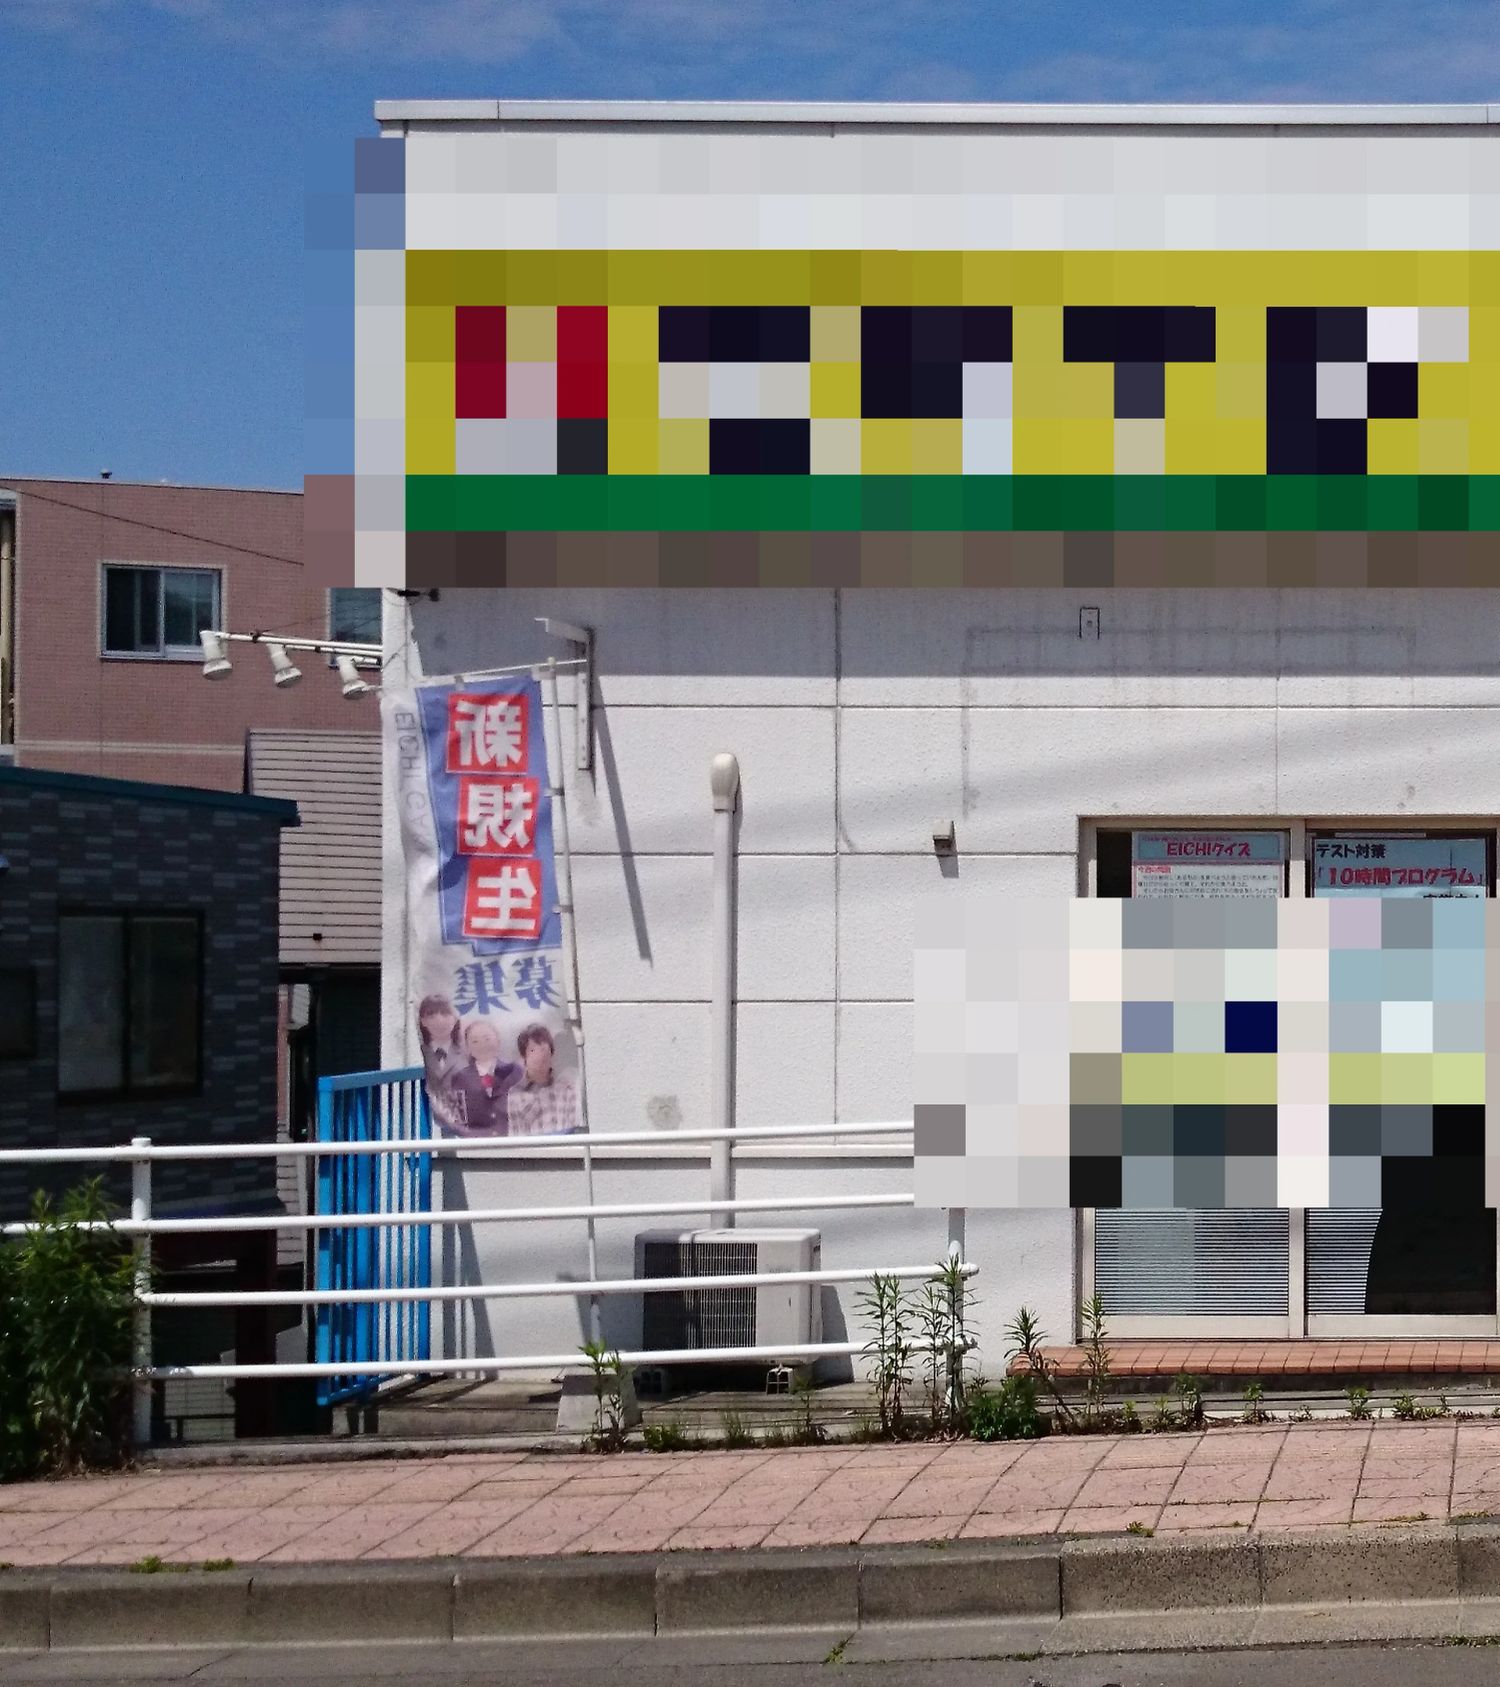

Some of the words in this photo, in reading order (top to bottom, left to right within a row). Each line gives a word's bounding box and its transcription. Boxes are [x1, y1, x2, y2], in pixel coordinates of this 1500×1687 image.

[1316, 843, 1387, 859] テスト対策
